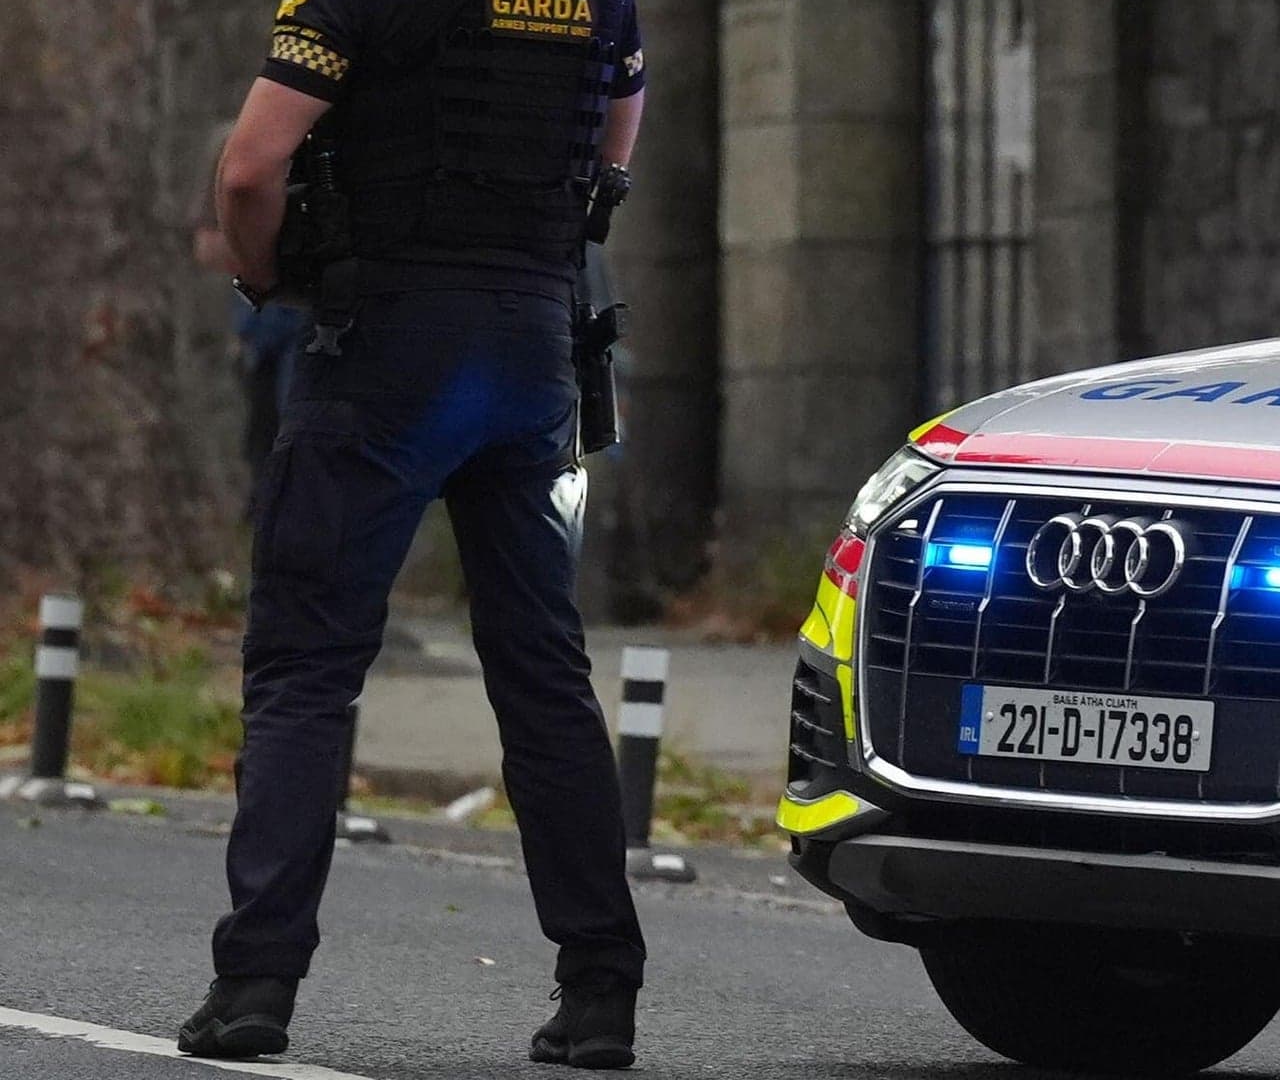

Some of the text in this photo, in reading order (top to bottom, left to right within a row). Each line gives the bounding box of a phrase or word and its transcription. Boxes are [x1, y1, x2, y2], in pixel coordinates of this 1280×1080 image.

[1053, 694, 1078, 706] BAILE
[1105, 697, 1138, 710] CLIATH
[959, 726, 978, 743] IRL
[997, 703, 1194, 764] 221-D-17338
